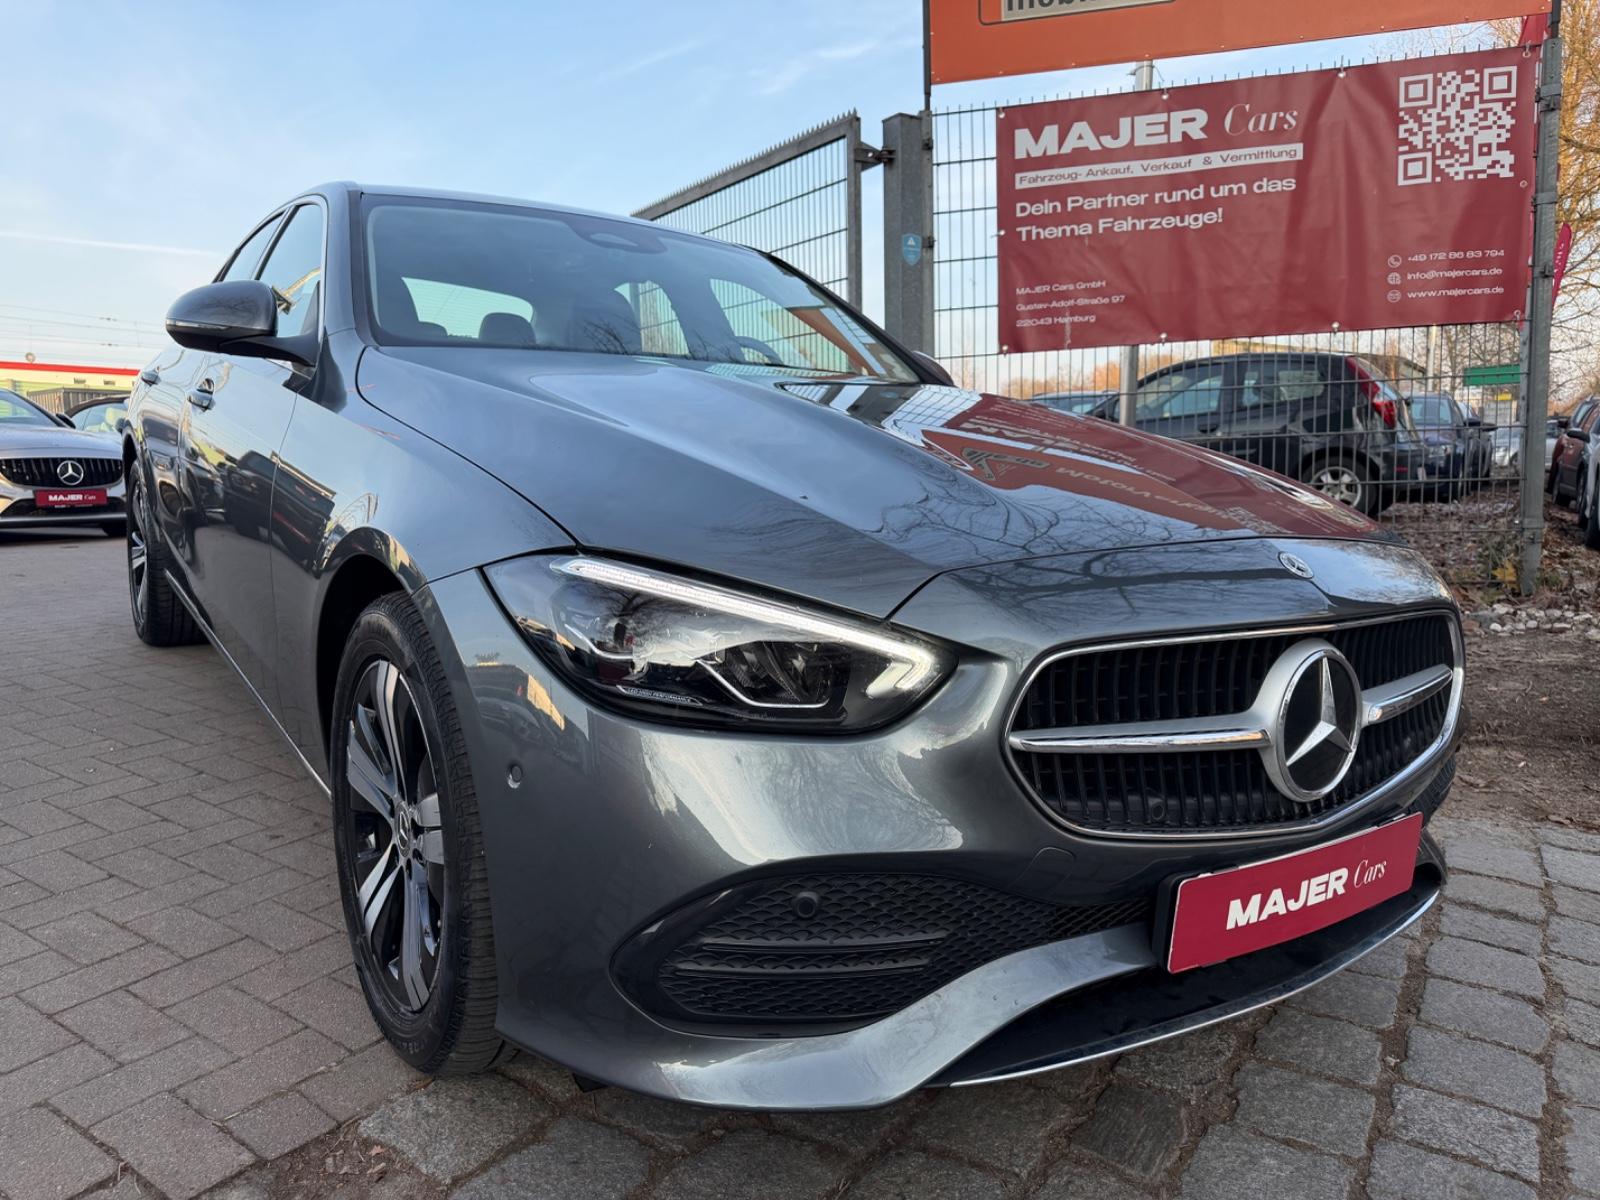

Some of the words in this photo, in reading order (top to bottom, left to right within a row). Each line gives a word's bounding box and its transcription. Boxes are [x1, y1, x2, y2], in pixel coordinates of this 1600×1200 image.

[1014, 108, 1209, 159] MAJER
[1224, 103, 1298, 136] Cars
[1019, 171, 1082, 186] Fahrzeug-
[1141, 159, 1192, 172] Verkauf
[1202, 155, 1213, 166] &
[1220, 147, 1297, 164] Vermittlung
[1015, 201, 1061, 217] Dein
[1067, 192, 1149, 212] Partner
[1155, 184, 1204, 204] rund
[1210, 182, 1247, 198] um
[1253, 177, 1297, 194] das
[1016, 221, 1093, 241] Thema
[1098, 207, 1223, 234] Fahrzeuge!
[1407, 253, 1427, 262] +49
[1429, 252, 1447, 260] 172
[1466, 250, 1482, 258] 83
[1484, 249, 1505, 257] 794
[1016, 284, 1050, 294] MAJER
[1052, 283, 1075, 291] Cars
[1076, 280, 1106, 289] GmbH
[1407, 286, 1504, 298] www.majercars.de
[1054, 315, 1096, 324] Hamburg
[48, 493, 83, 502] MAJER
[1226, 867, 1348, 930] MAJER
[1354, 859, 1387, 889] Cars
